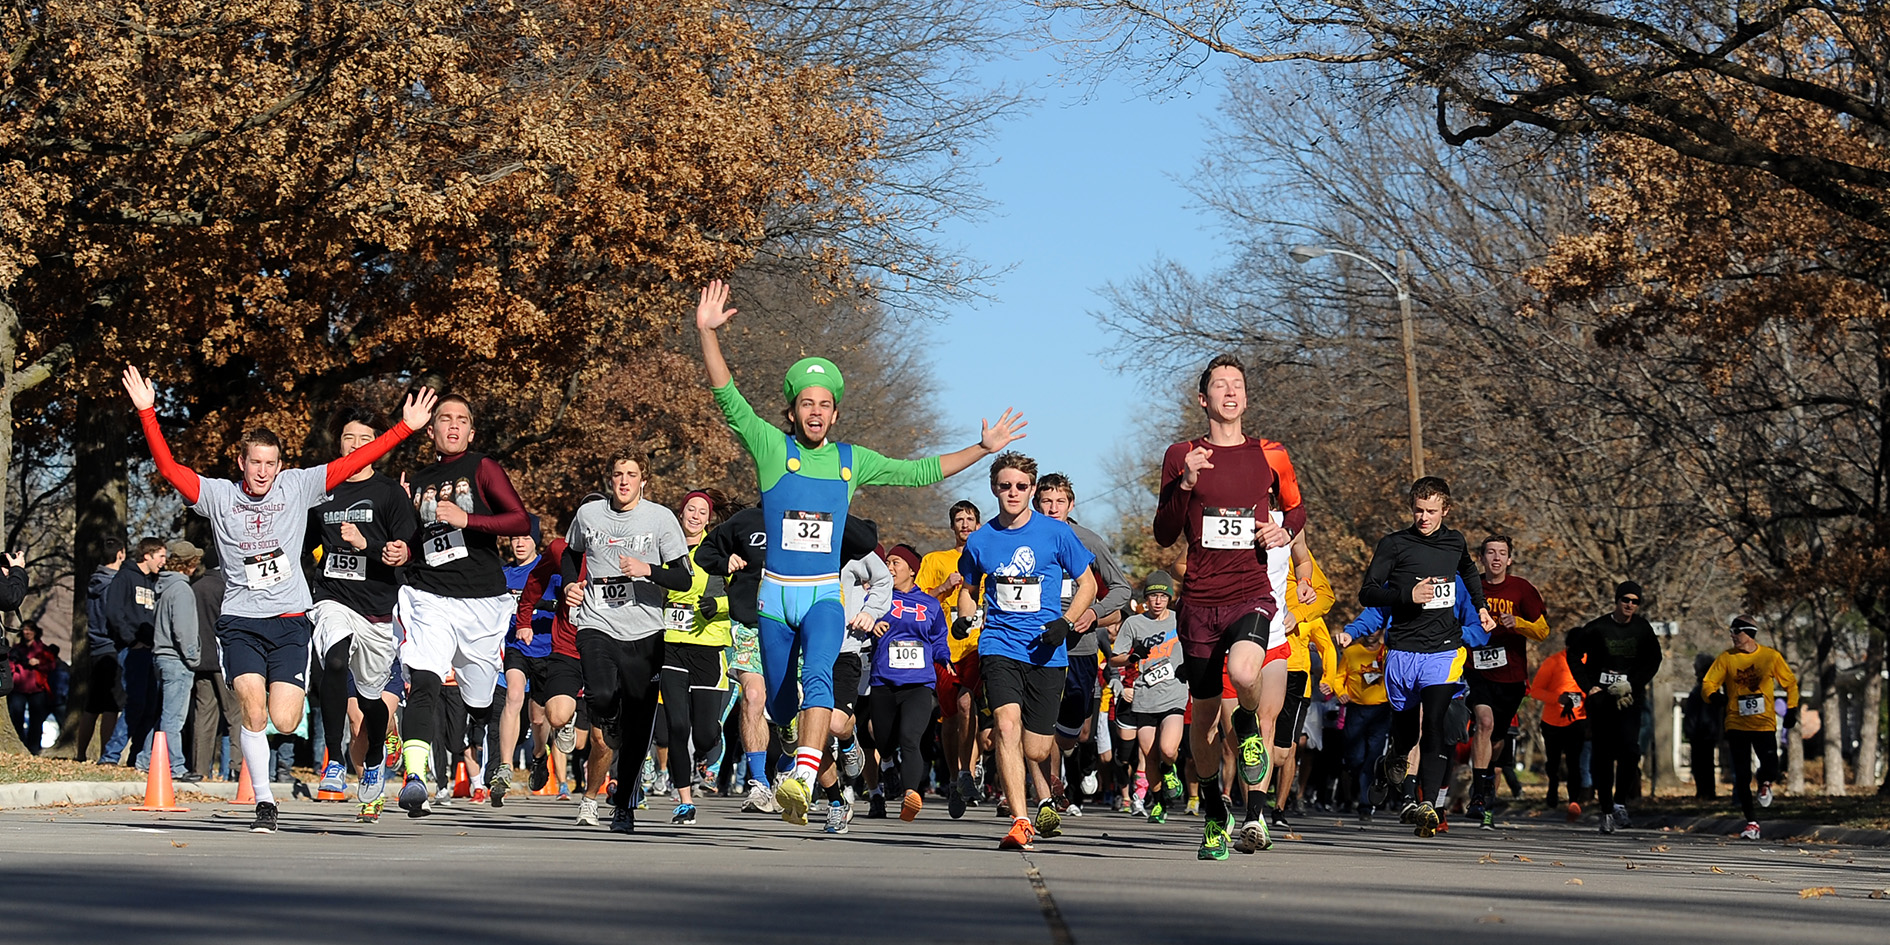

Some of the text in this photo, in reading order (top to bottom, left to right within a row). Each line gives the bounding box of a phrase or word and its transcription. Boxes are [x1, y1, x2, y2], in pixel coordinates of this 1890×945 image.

[798, 522, 820, 538] 32
[1218, 519, 1242, 536] 35
[240, 539, 280, 550] MEN'S SOCCER
[433, 534, 453, 552] 81
[257, 560, 279, 577] 74
[332, 555, 358, 570] 159
[601, 584, 627, 599] 102
[1013, 586, 1023, 600] 7
[1434, 584, 1451, 598] 03
[1487, 597, 1514, 615] STON
[671, 610, 685, 621] 40
[896, 648, 918, 660] 106
[1479, 649, 1499, 661] 120
[1149, 666, 1170, 682] 323
[1745, 699, 1758, 709] 69
